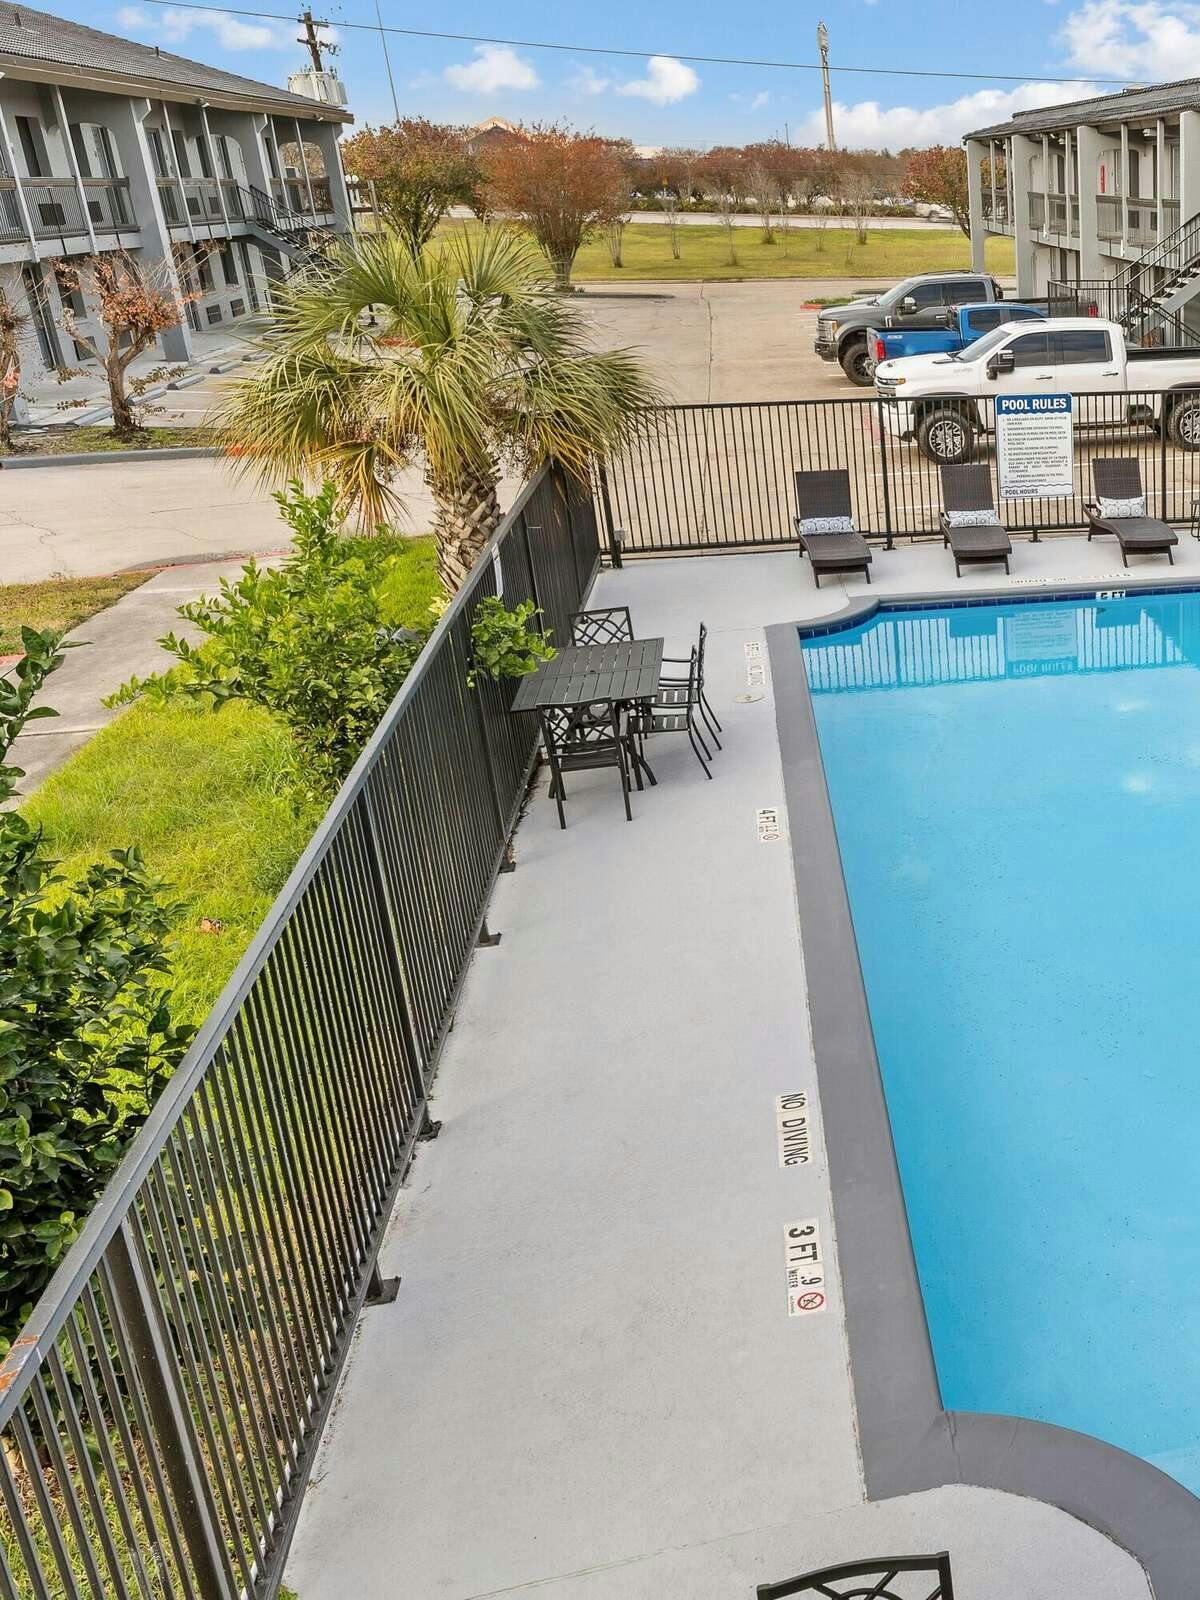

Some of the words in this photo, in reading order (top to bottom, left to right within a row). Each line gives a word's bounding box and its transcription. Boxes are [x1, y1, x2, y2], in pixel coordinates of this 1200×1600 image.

[1002, 399, 1031, 410] POOL
[1032, 398, 1067, 410] RULES
[759, 815, 777, 824] FT
[780, 1092, 807, 1110] NO
[782, 1117, 809, 1167] DIVING
[788, 1225, 816, 1239] 3
[789, 1241, 818, 1262] FT
